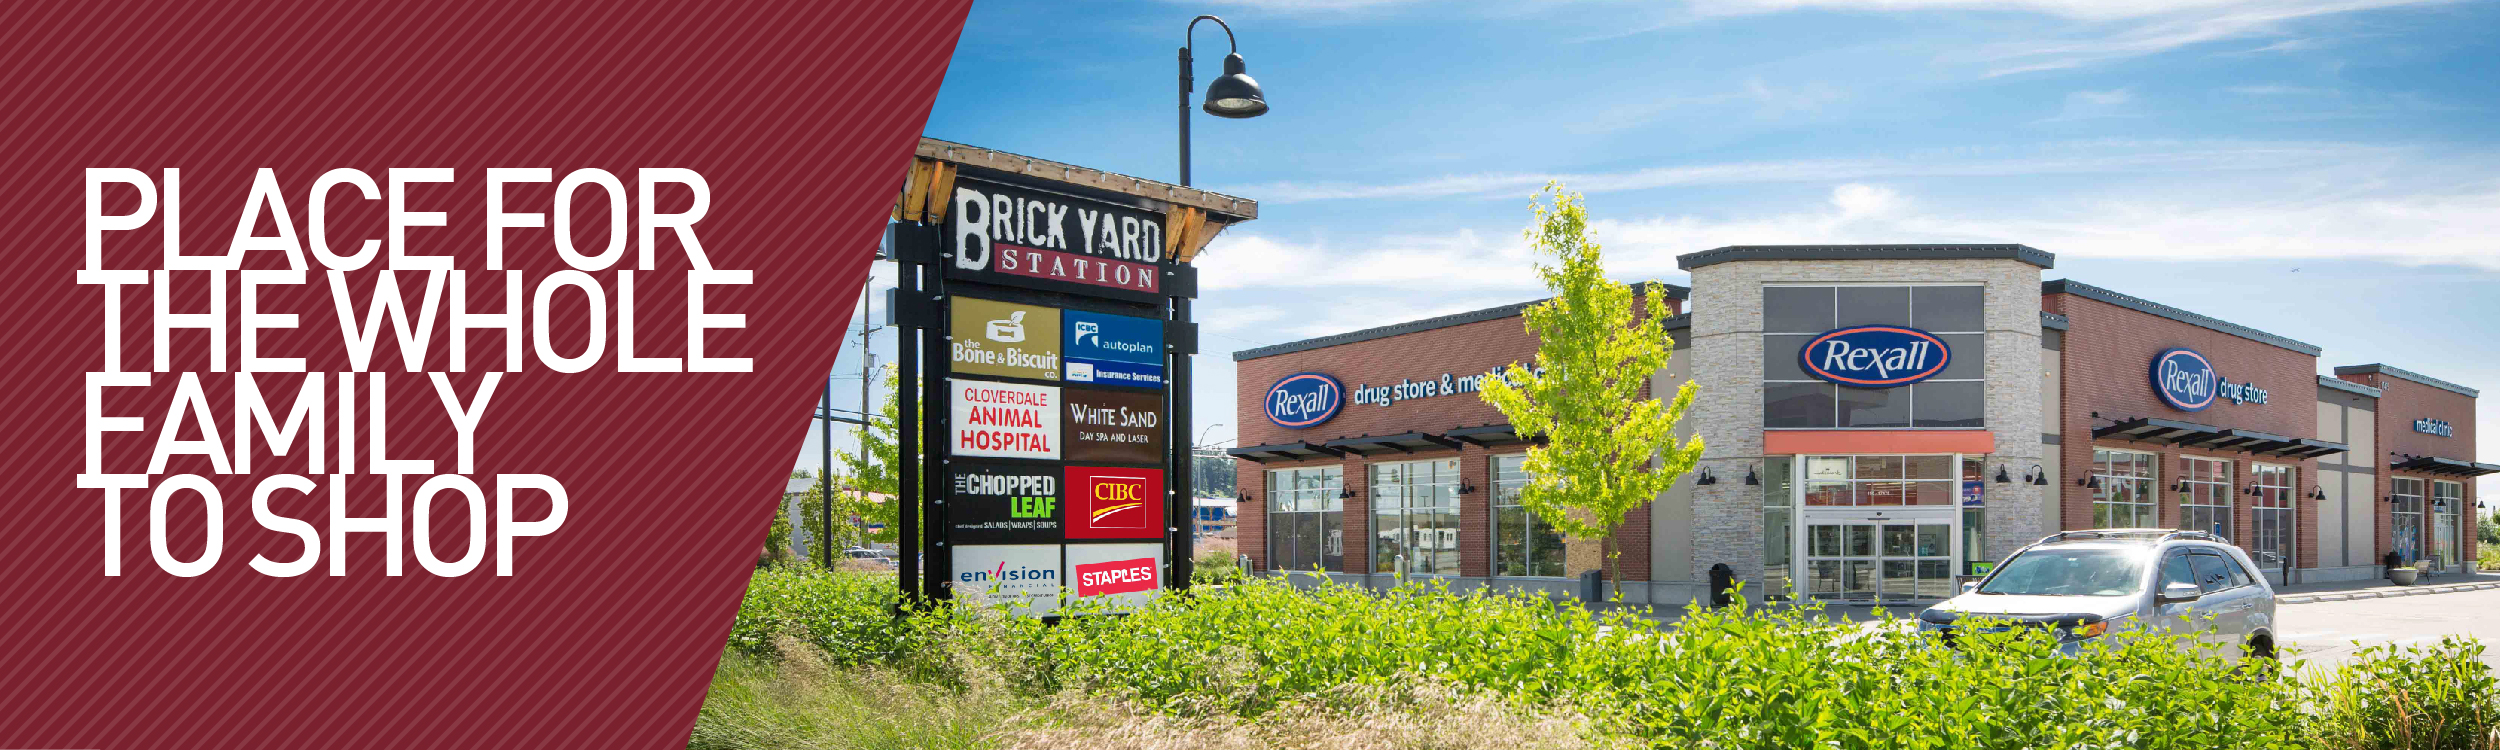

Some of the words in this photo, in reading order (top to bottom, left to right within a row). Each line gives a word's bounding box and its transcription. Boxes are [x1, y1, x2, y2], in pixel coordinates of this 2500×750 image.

[955, 186, 1069, 271] BRICK
[1078, 207, 1161, 263] YARD
[1001, 249, 1153, 289] STATION
[1077, 323, 1097, 333] ICBC
[964, 339, 980, 348] the
[1102, 340, 1153, 353] autoplan
[952, 342, 996, 365] Bone
[997, 352, 1005, 364] &
[1006, 347, 1058, 370] Biscuit
[1823, 340, 1930, 379] Rexall
[1095, 369, 1131, 381] Insurance
[1132, 372, 1161, 383] Services
[2166, 359, 2210, 403] Rexall
[2220, 376, 2243, 405] drug
[2244, 382, 2268, 405] store
[964, 387, 1048, 407] CLOVERDALE
[1274, 383, 1329, 420] Rexall
[1354, 384, 1390, 407] drug
[1393, 378, 1437, 401] store
[1440, 373, 1454, 396] &
[968, 405, 1043, 428] ANIMAL
[1069, 403, 1116, 426] WHITE
[1120, 406, 1158, 428] SAND
[960, 429, 1051, 453] HOSPITAL
[1080, 431, 1094, 441] DAY
[1096, 432, 1109, 442] SPA
[1110, 433, 1126, 443] AND
[1128, 434, 1149, 444] LASER
[955, 473, 966, 495] THE
[966, 473, 1056, 496] CHOPPED
[1094, 482, 1142, 501] CIBC
[1010, 496, 1056, 518] LEAF
[960, 561, 1055, 582] envision
[1082, 566, 1152, 587] STAPLES
